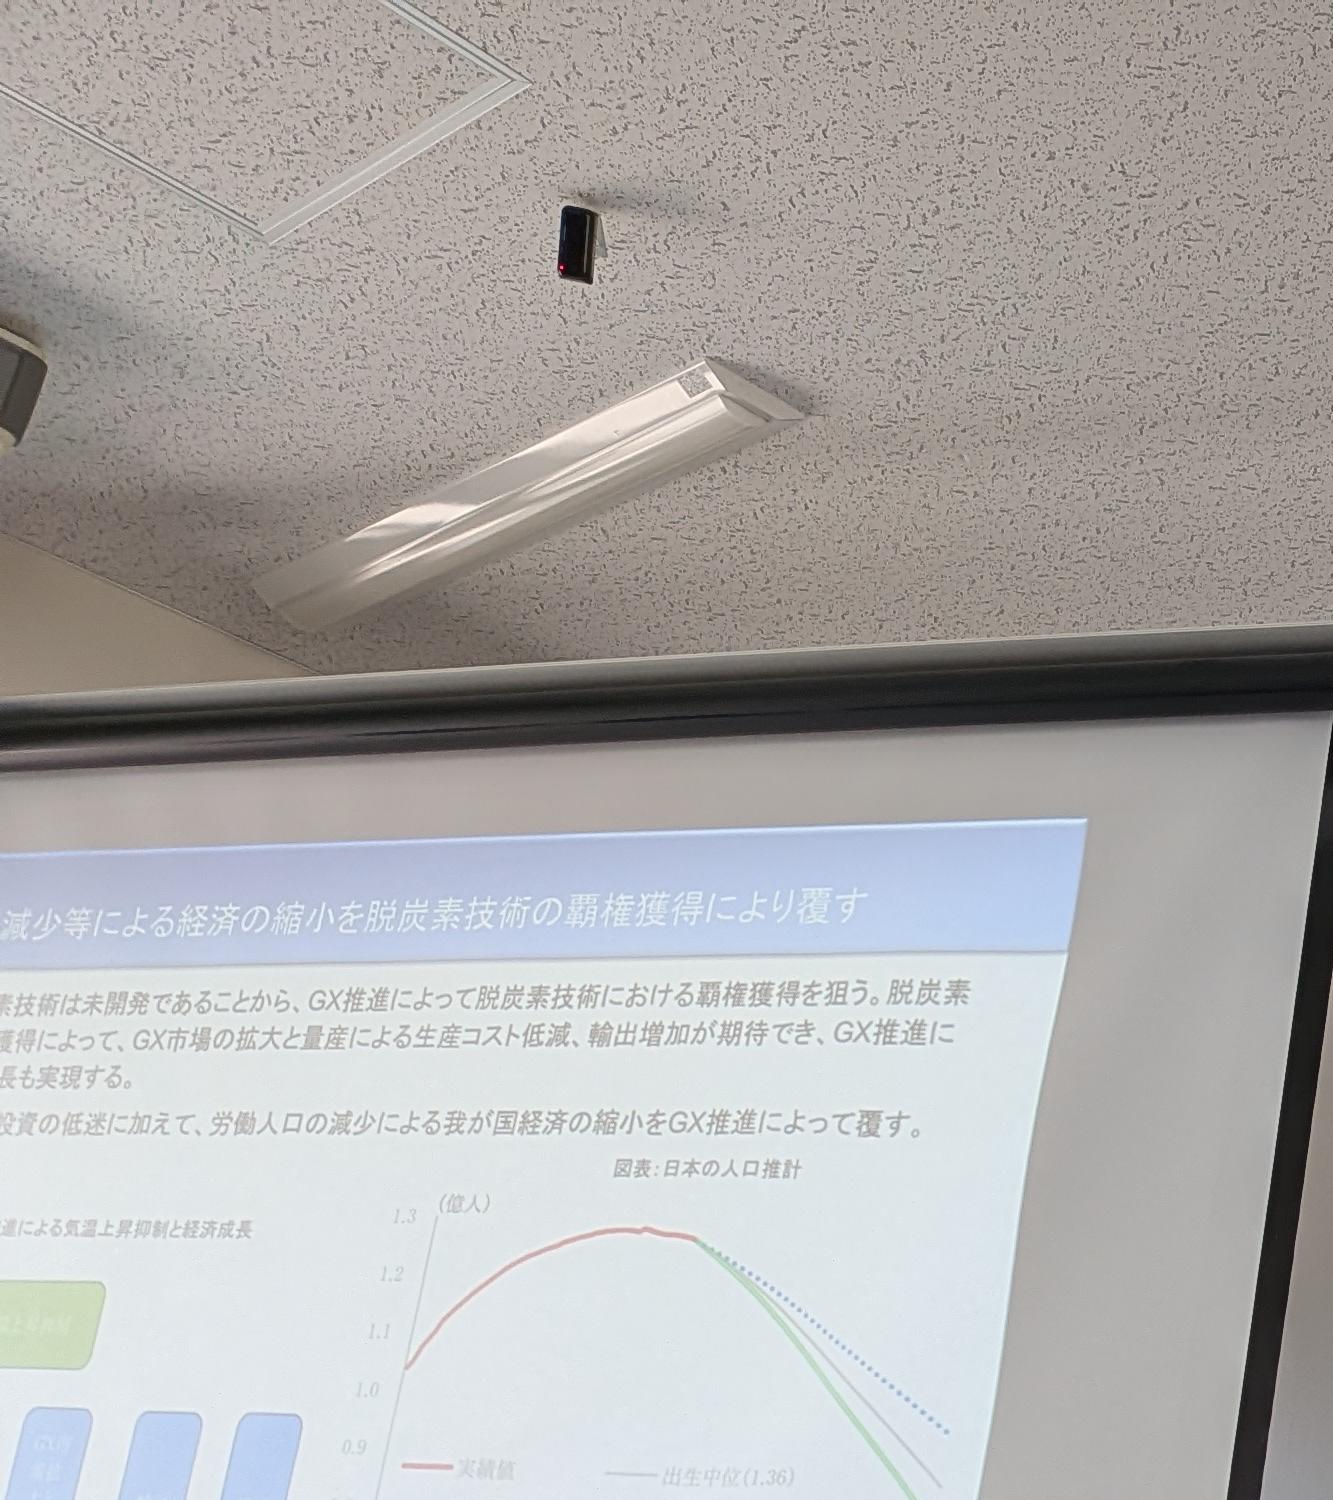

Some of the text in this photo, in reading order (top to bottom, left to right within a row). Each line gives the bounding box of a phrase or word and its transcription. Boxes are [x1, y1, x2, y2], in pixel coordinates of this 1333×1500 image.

[393, 1209, 417, 1224] 1.3
[380, 1266, 404, 1282] 1.2
[342, 1439, 367, 1456] 0.9
